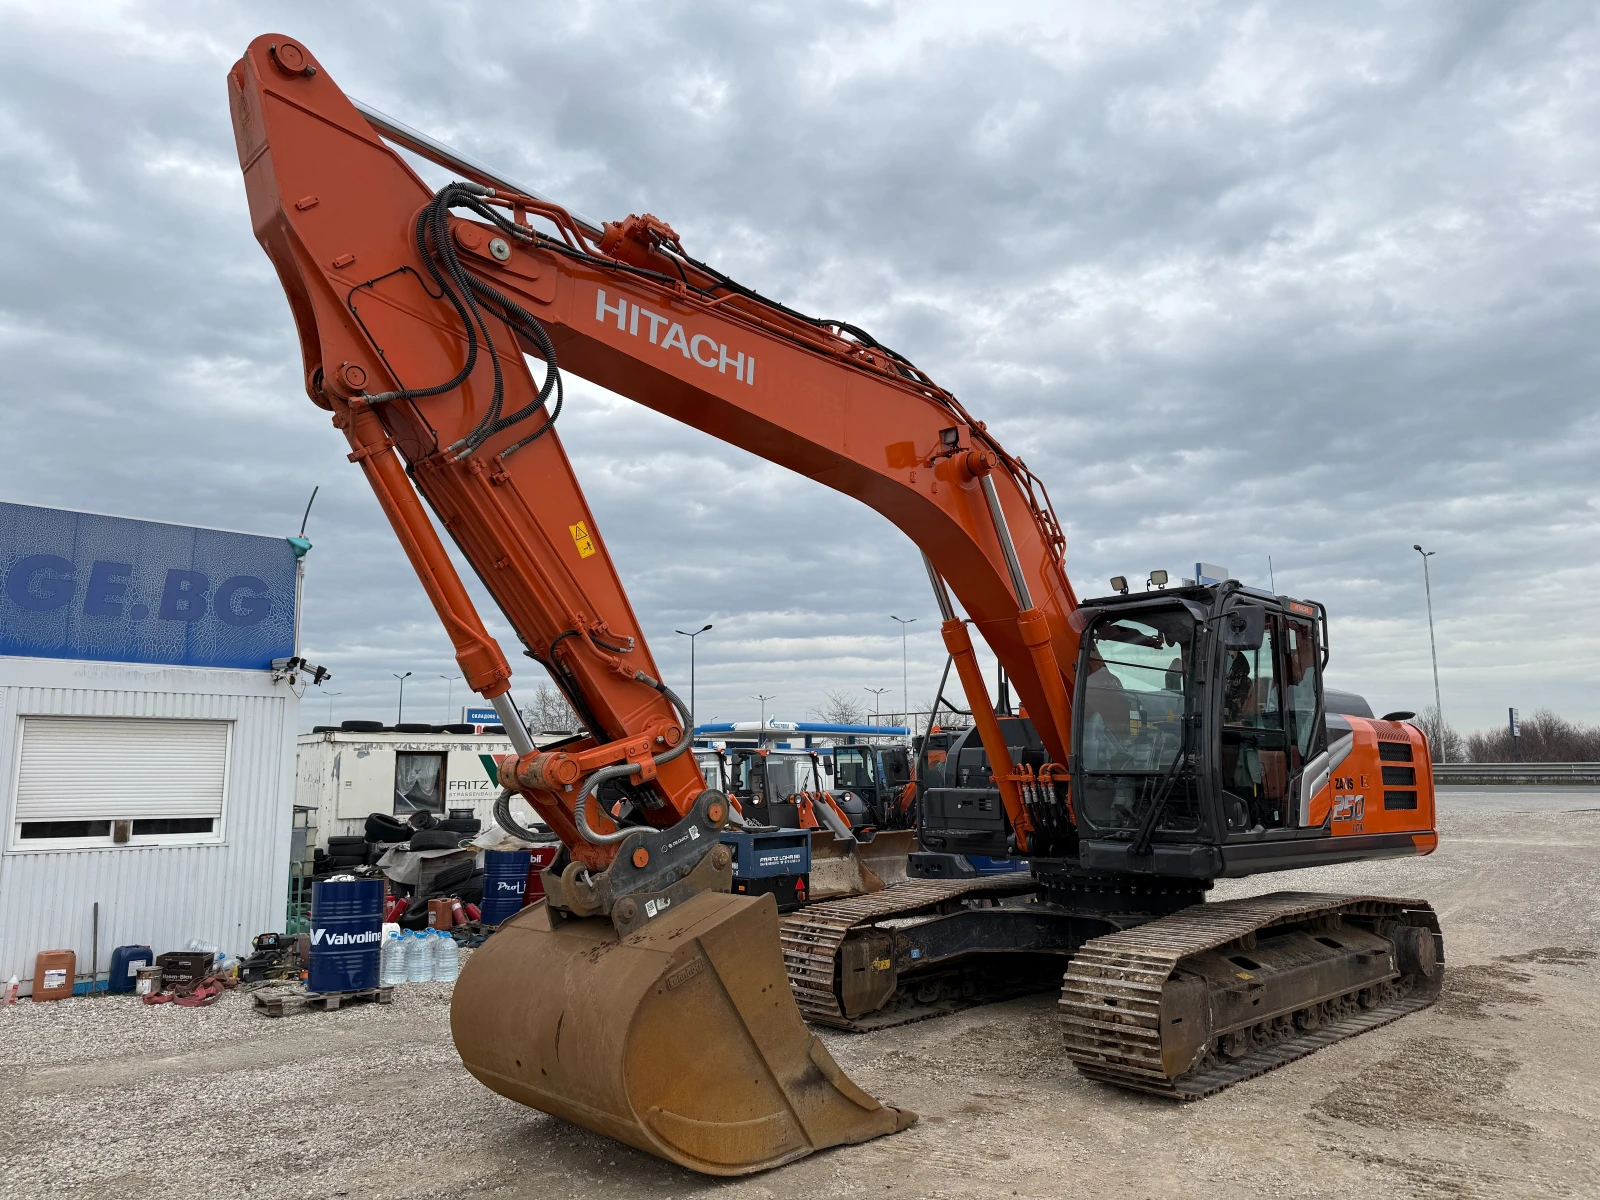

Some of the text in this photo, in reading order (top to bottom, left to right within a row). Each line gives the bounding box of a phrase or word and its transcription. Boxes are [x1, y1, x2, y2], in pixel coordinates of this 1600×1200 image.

[596, 288, 755, 386] HITACHI
[6, 553, 272, 627] GE.BG
[449, 780, 489, 790] FRITZ
[1333, 795, 1365, 821] 250
[497, 881, 527, 894] ProLi
[325, 931, 382, 946] Valvoline
